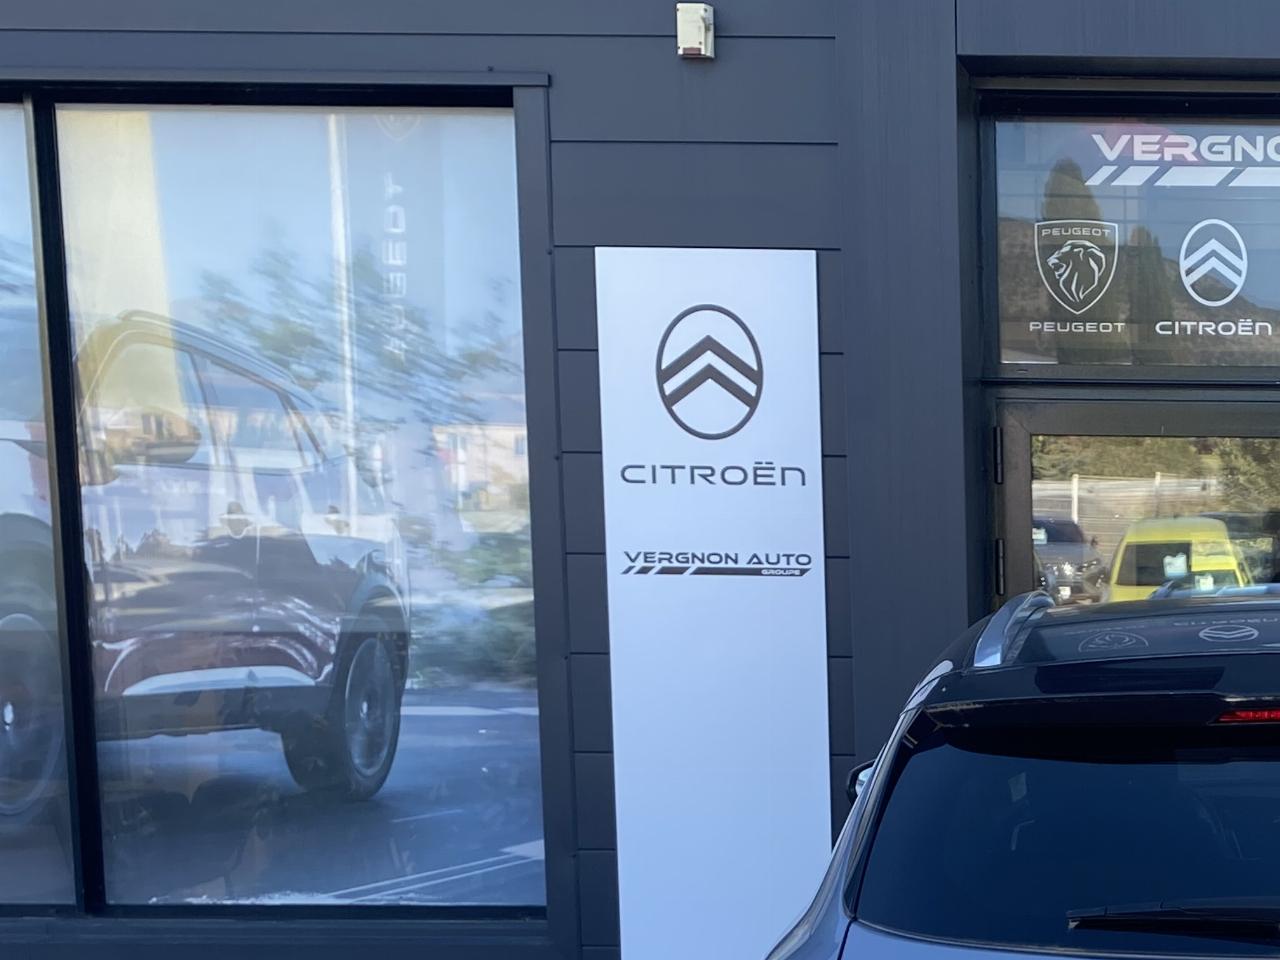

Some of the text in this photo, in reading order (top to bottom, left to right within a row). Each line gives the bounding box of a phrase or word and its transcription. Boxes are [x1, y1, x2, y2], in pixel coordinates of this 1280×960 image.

[1041, 227, 1112, 238] PEUGEOT
[1029, 322, 1125, 333] PEUGEOT
[1155, 319, 1272, 336] CITROËN
[621, 461, 806, 486] CITROËN
[624, 551, 812, 566] VERGNON AUTO
